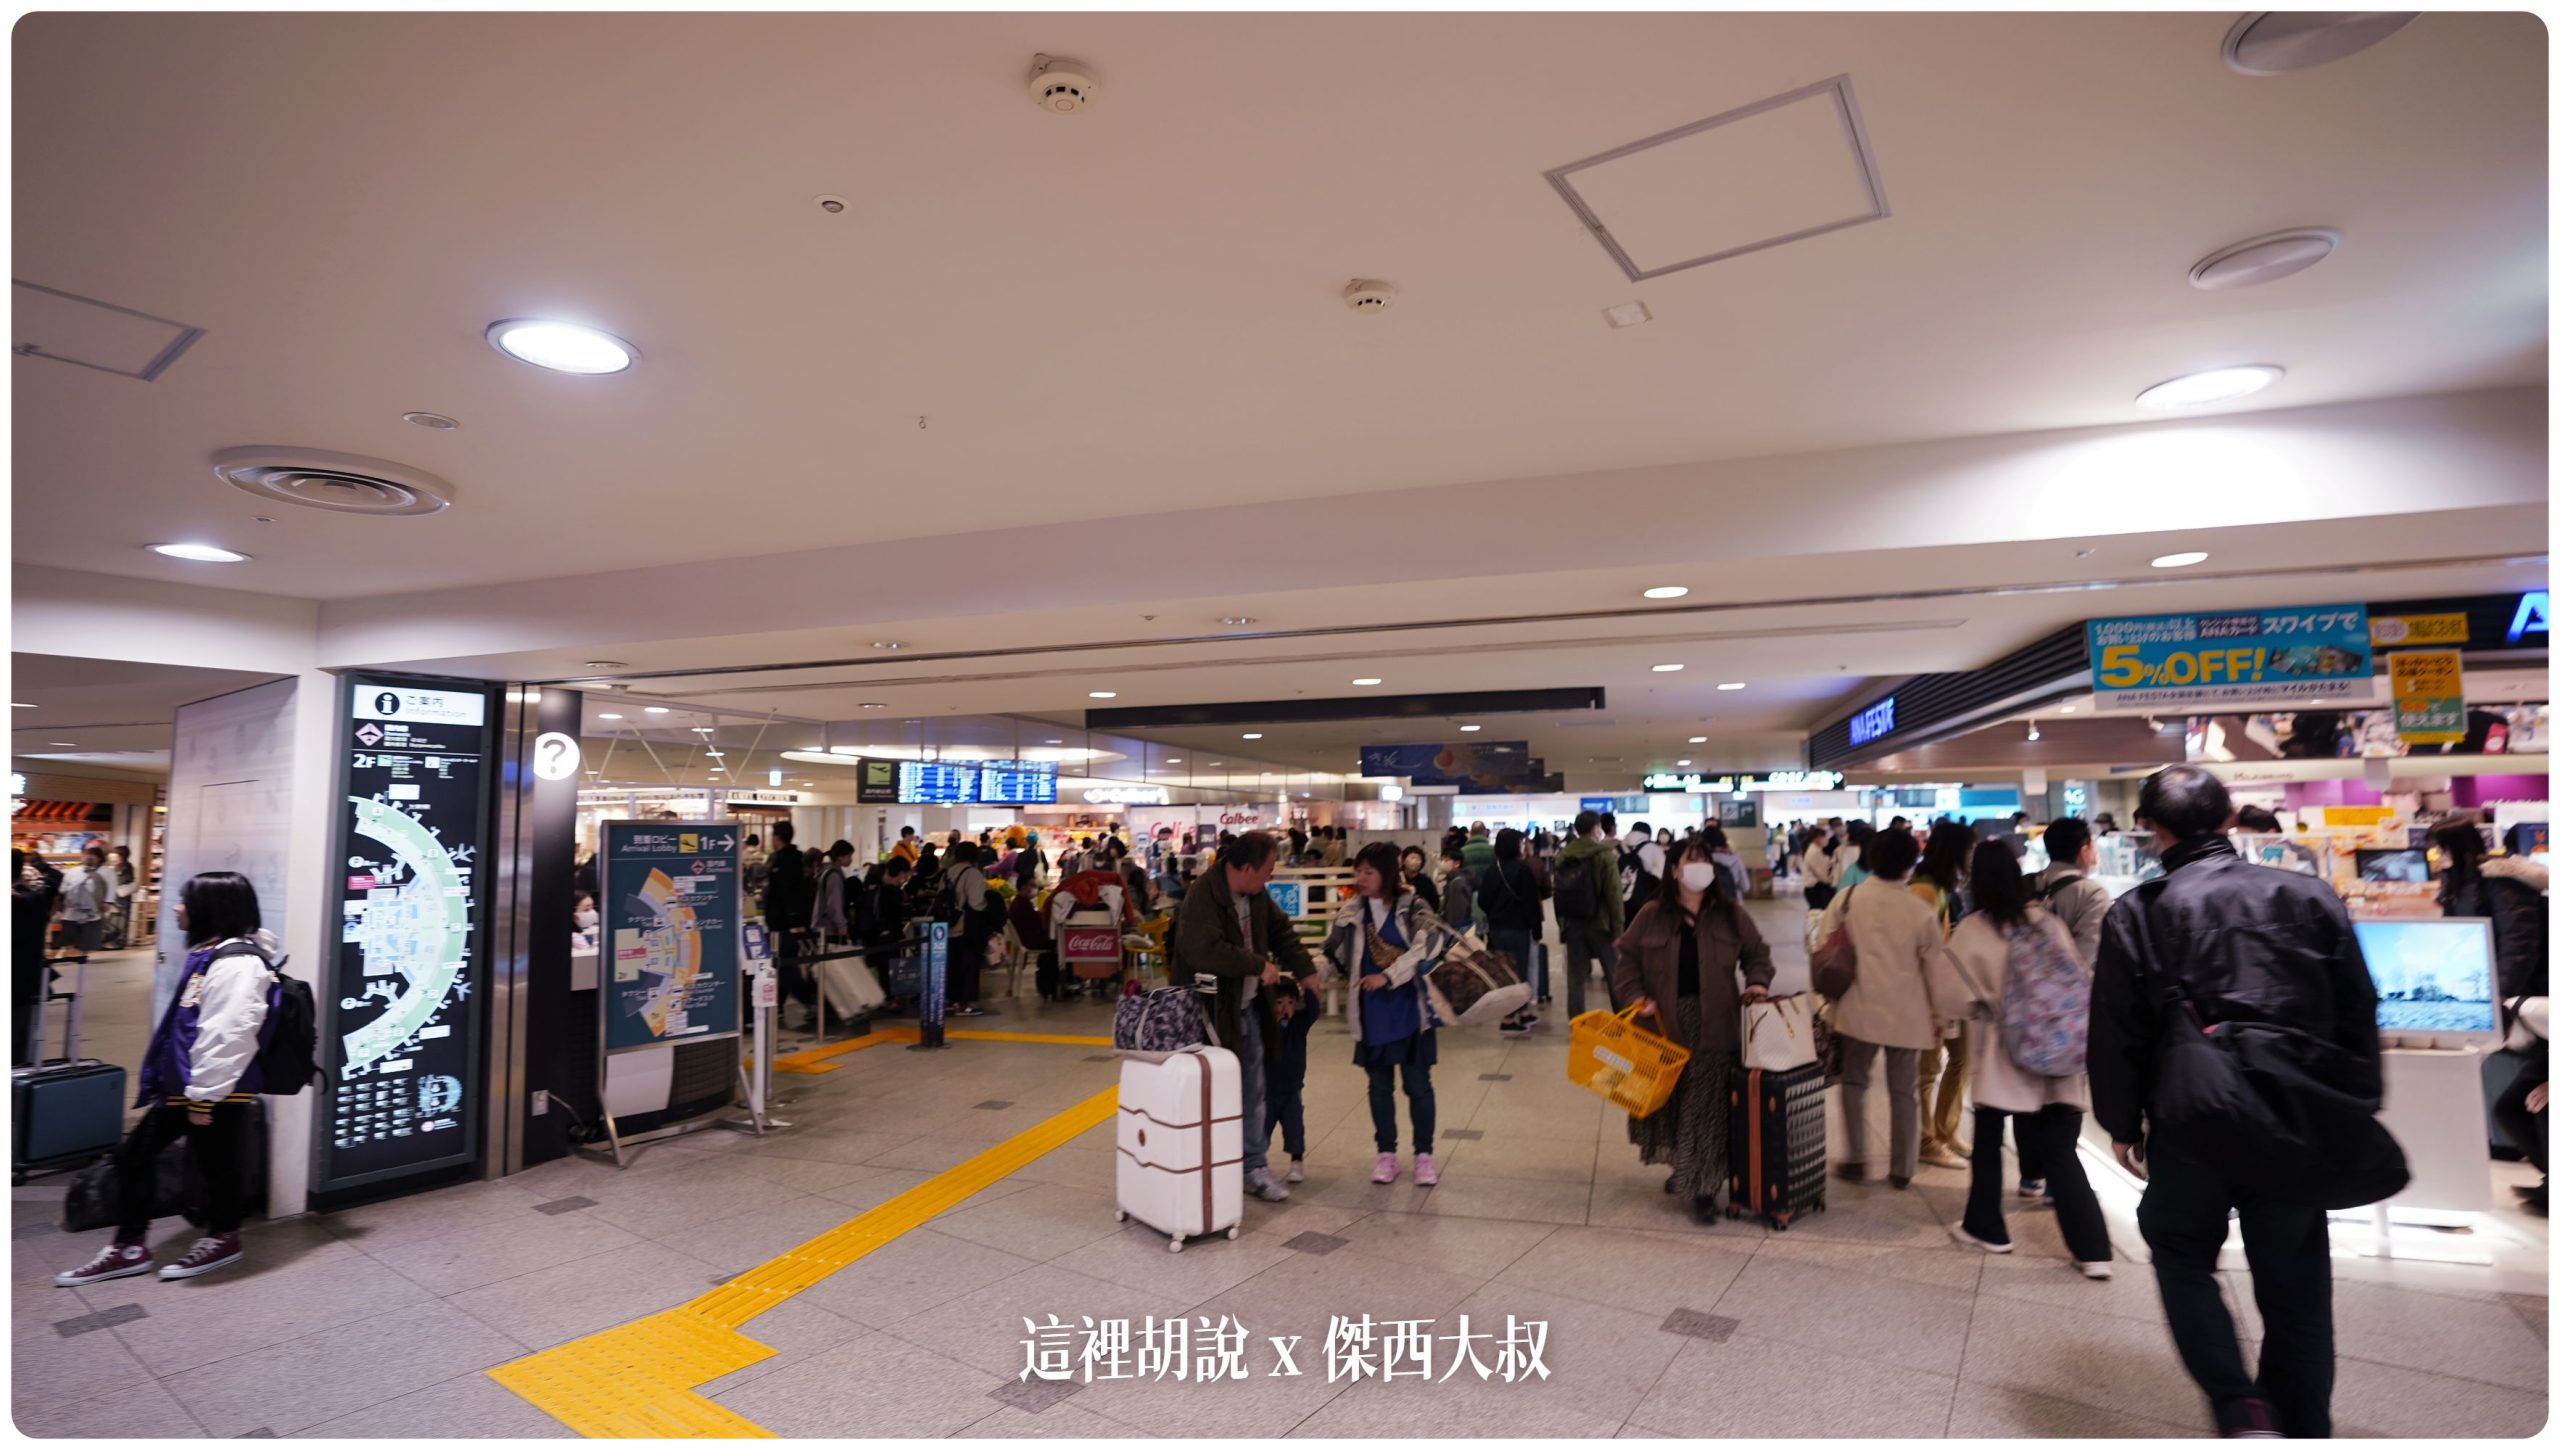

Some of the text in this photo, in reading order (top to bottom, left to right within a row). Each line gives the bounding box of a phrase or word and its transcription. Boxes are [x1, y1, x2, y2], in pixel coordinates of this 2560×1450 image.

[2263, 611, 2359, 635] スワイプで
[2099, 644, 2267, 688] 5%OFF!
[406, 695, 444, 708] ご案内
[353, 753, 377, 769] 2F
[1220, 811, 1259, 825] Calbee
[621, 844, 678, 854] Arrival Lobby
[700, 836, 717, 850] 1F
